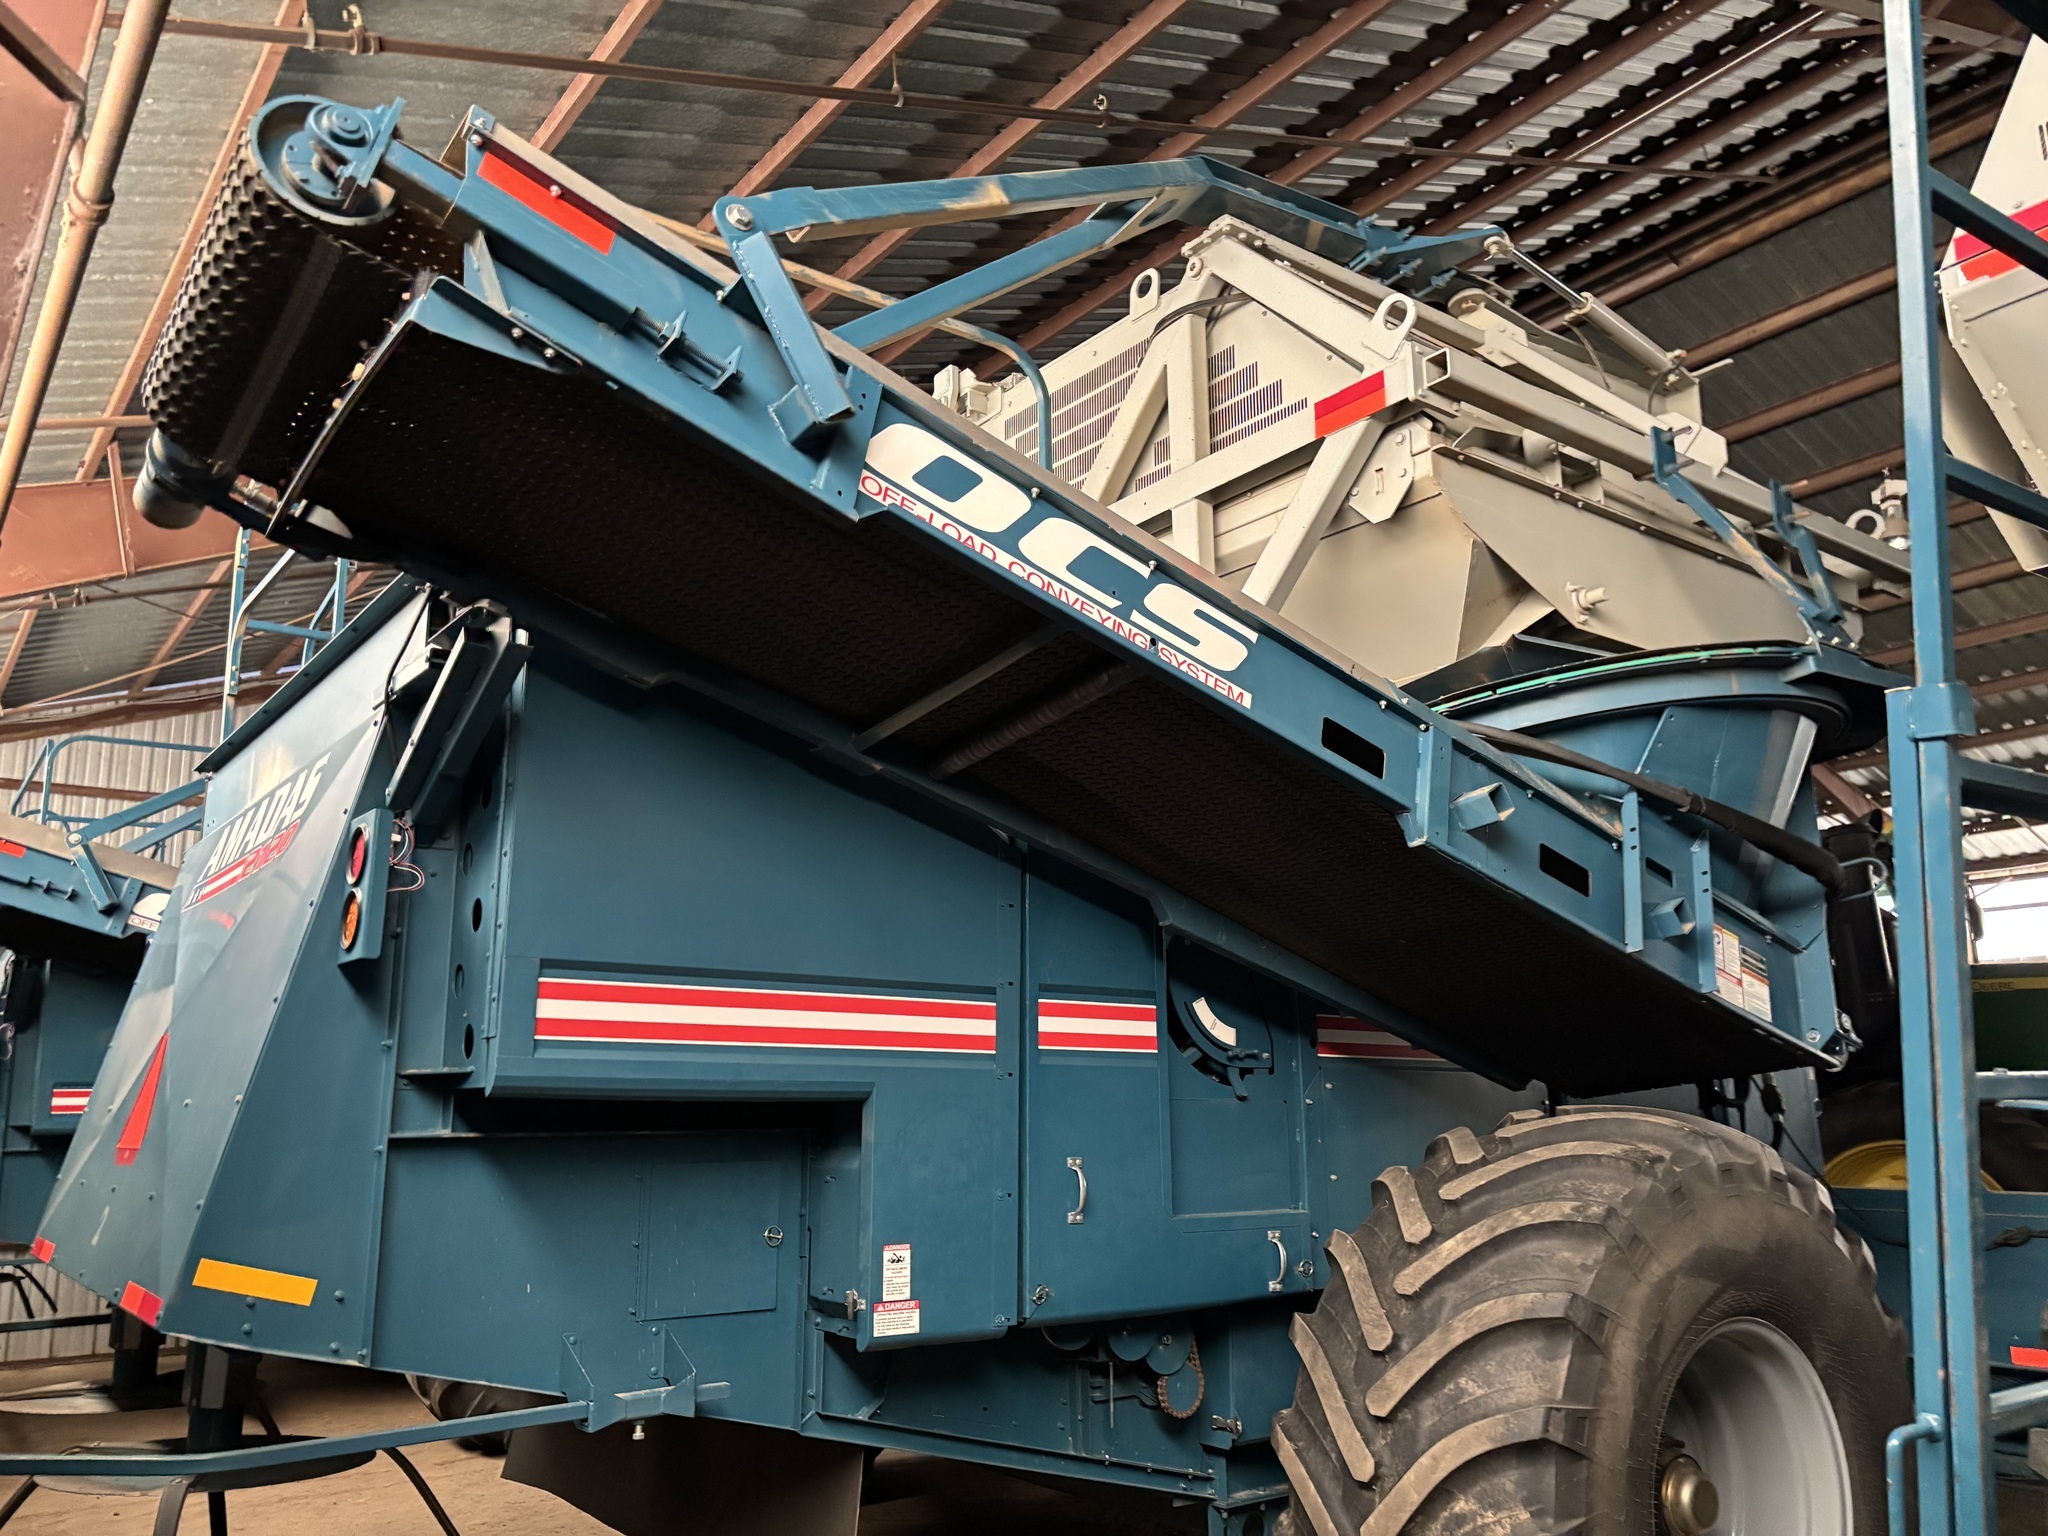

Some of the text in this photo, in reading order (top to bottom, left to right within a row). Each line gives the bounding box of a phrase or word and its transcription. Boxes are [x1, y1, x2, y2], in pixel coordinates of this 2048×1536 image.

[865, 423, 1258, 671] OCS
[1008, 561, 1148, 649] CONVEYING
[1158, 647, 1245, 704] SYSTEM
[197, 752, 331, 882] AMADAS
[885, 1301, 915, 1310] DANGER
